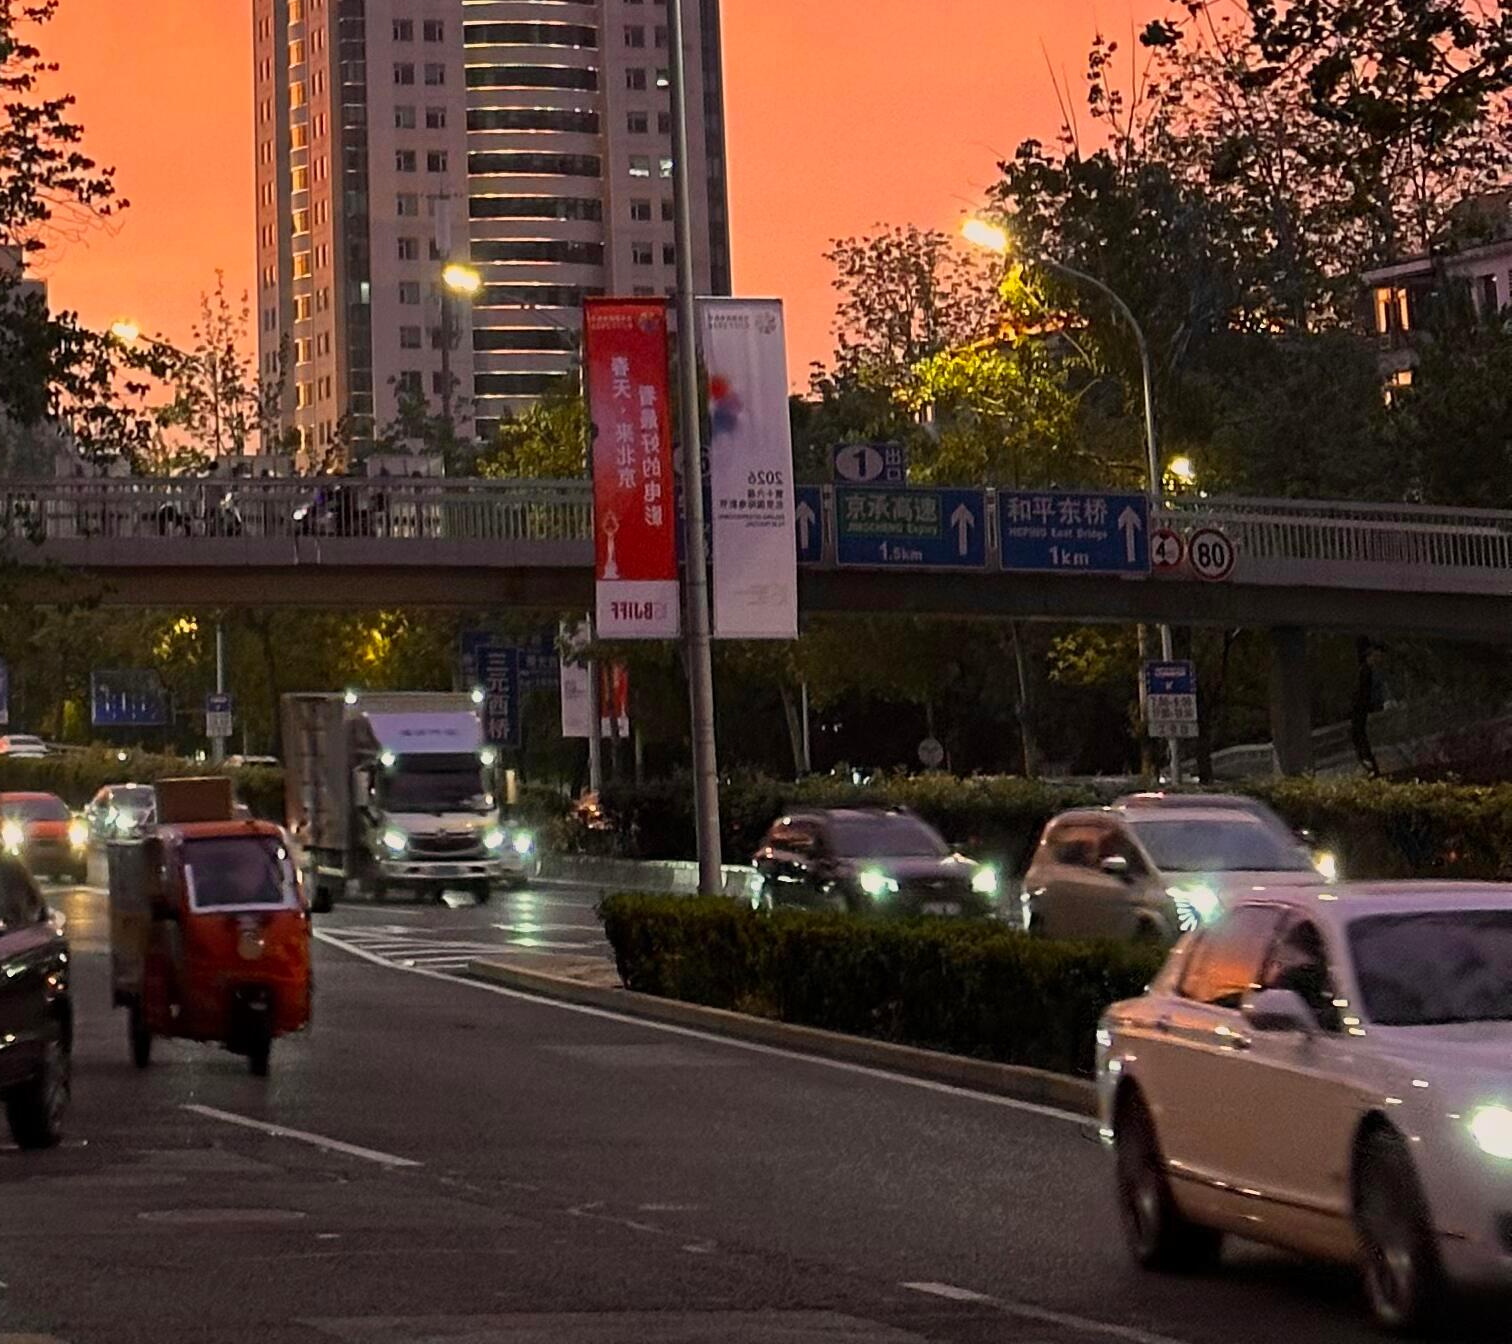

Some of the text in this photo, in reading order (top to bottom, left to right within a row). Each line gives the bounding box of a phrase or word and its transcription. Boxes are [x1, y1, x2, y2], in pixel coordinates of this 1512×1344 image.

[852, 449, 867, 478] 1
[885, 448, 902, 481] 出口
[845, 495, 937, 522] 京承高速
[1007, 496, 1108, 525] 和平东桥
[1048, 545, 1089, 566] 1km
[1197, 543, 1225, 568] 80
[486, 652, 510, 740] 三元西桥
